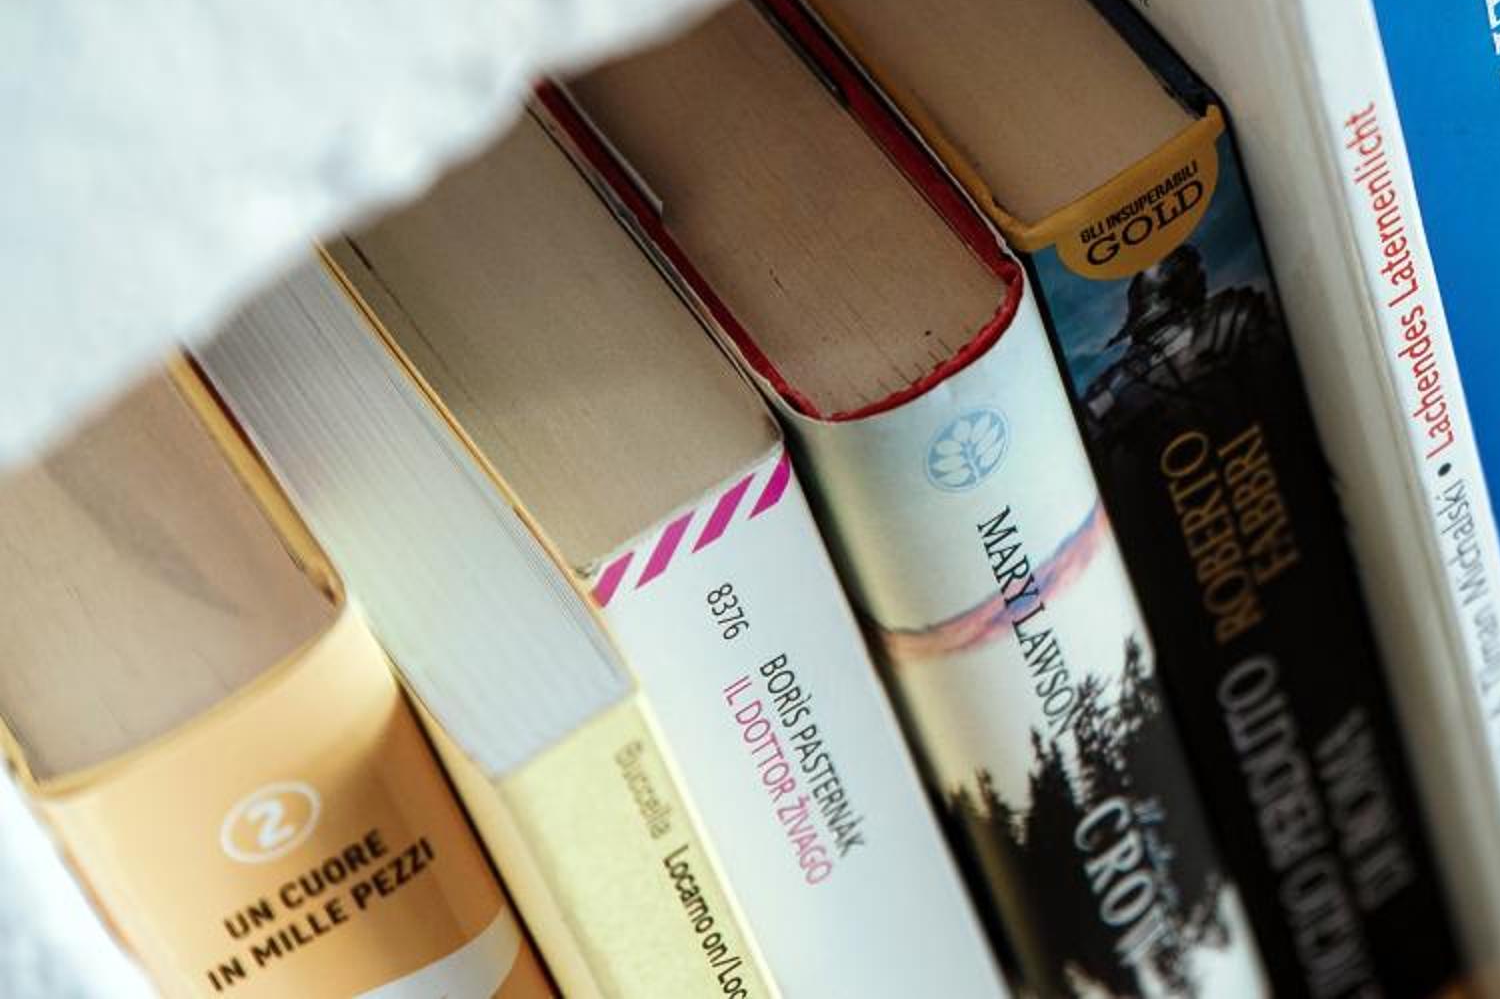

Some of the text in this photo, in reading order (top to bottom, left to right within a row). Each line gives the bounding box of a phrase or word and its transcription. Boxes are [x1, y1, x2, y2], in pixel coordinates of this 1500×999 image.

[1080, 159, 1198, 244] GLI INSUPERABILI
[1086, 179, 1204, 266] GOLD
[1344, 102, 1456, 459] Lachendes Laternenlicht
[1159, 431, 1264, 644] ROBERTO
[1219, 424, 1299, 586] FABBRI
[1436, 478, 1490, 607] Michalski
[706, 582, 750, 641] 8376
[976, 505, 1086, 738] MARY LAWSON
[723, 676, 751, 707] IL
[734, 700, 797, 803] DOTTOR
[243, 799, 294, 847] 2
[207, 836, 438, 992] IN MILLE PEZZI
[225, 828, 390, 941] UN CUORE
[662, 844, 715, 934] Locarno
